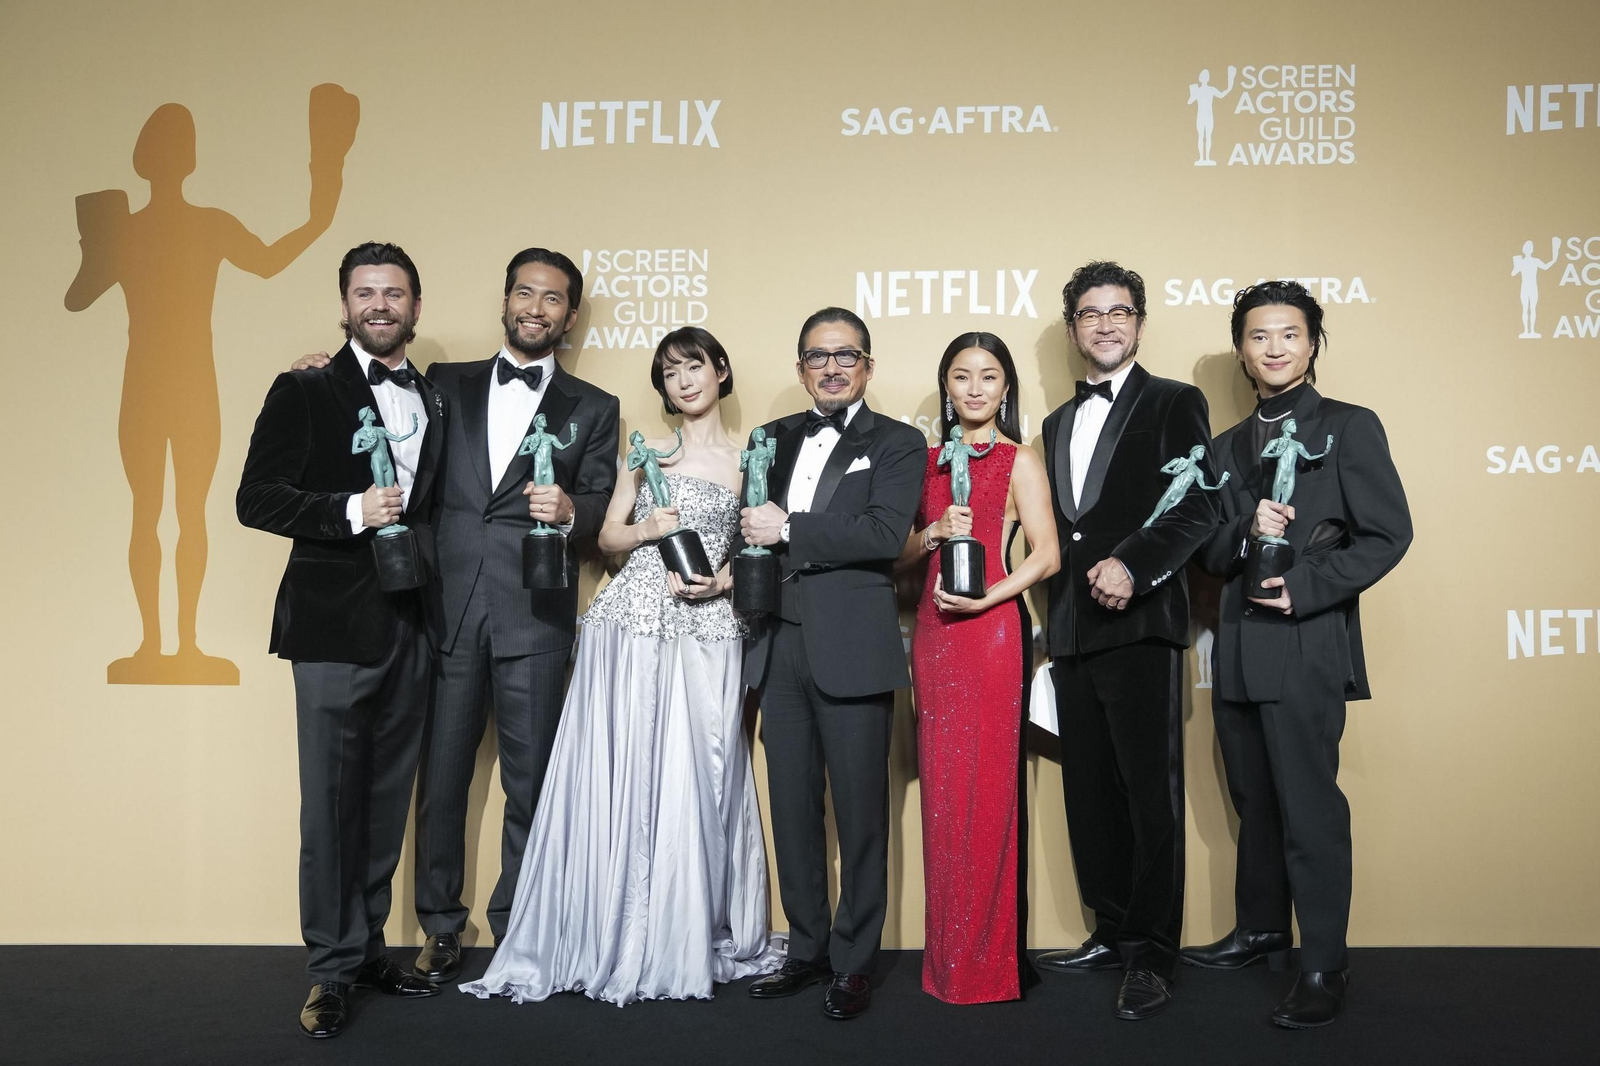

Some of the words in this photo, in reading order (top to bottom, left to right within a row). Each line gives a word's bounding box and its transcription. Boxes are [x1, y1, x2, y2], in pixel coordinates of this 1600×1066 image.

[1240, 64, 1356, 89] SCREEN
[1234, 90, 1356, 114] ACTORS
[1506, 83, 1600, 135] NET
[540, 98, 721, 151] NETFLIX
[1259, 116, 1356, 141] GUILD
[1227, 141, 1356, 166] AWARDS
[595, 248, 709, 273] SCREEN
[589, 274, 709, 298] ACTORS
[856, 269, 1038, 319] NETFLIX
[613, 300, 709, 325] GUILD
[1506, 608, 1600, 660] NET
